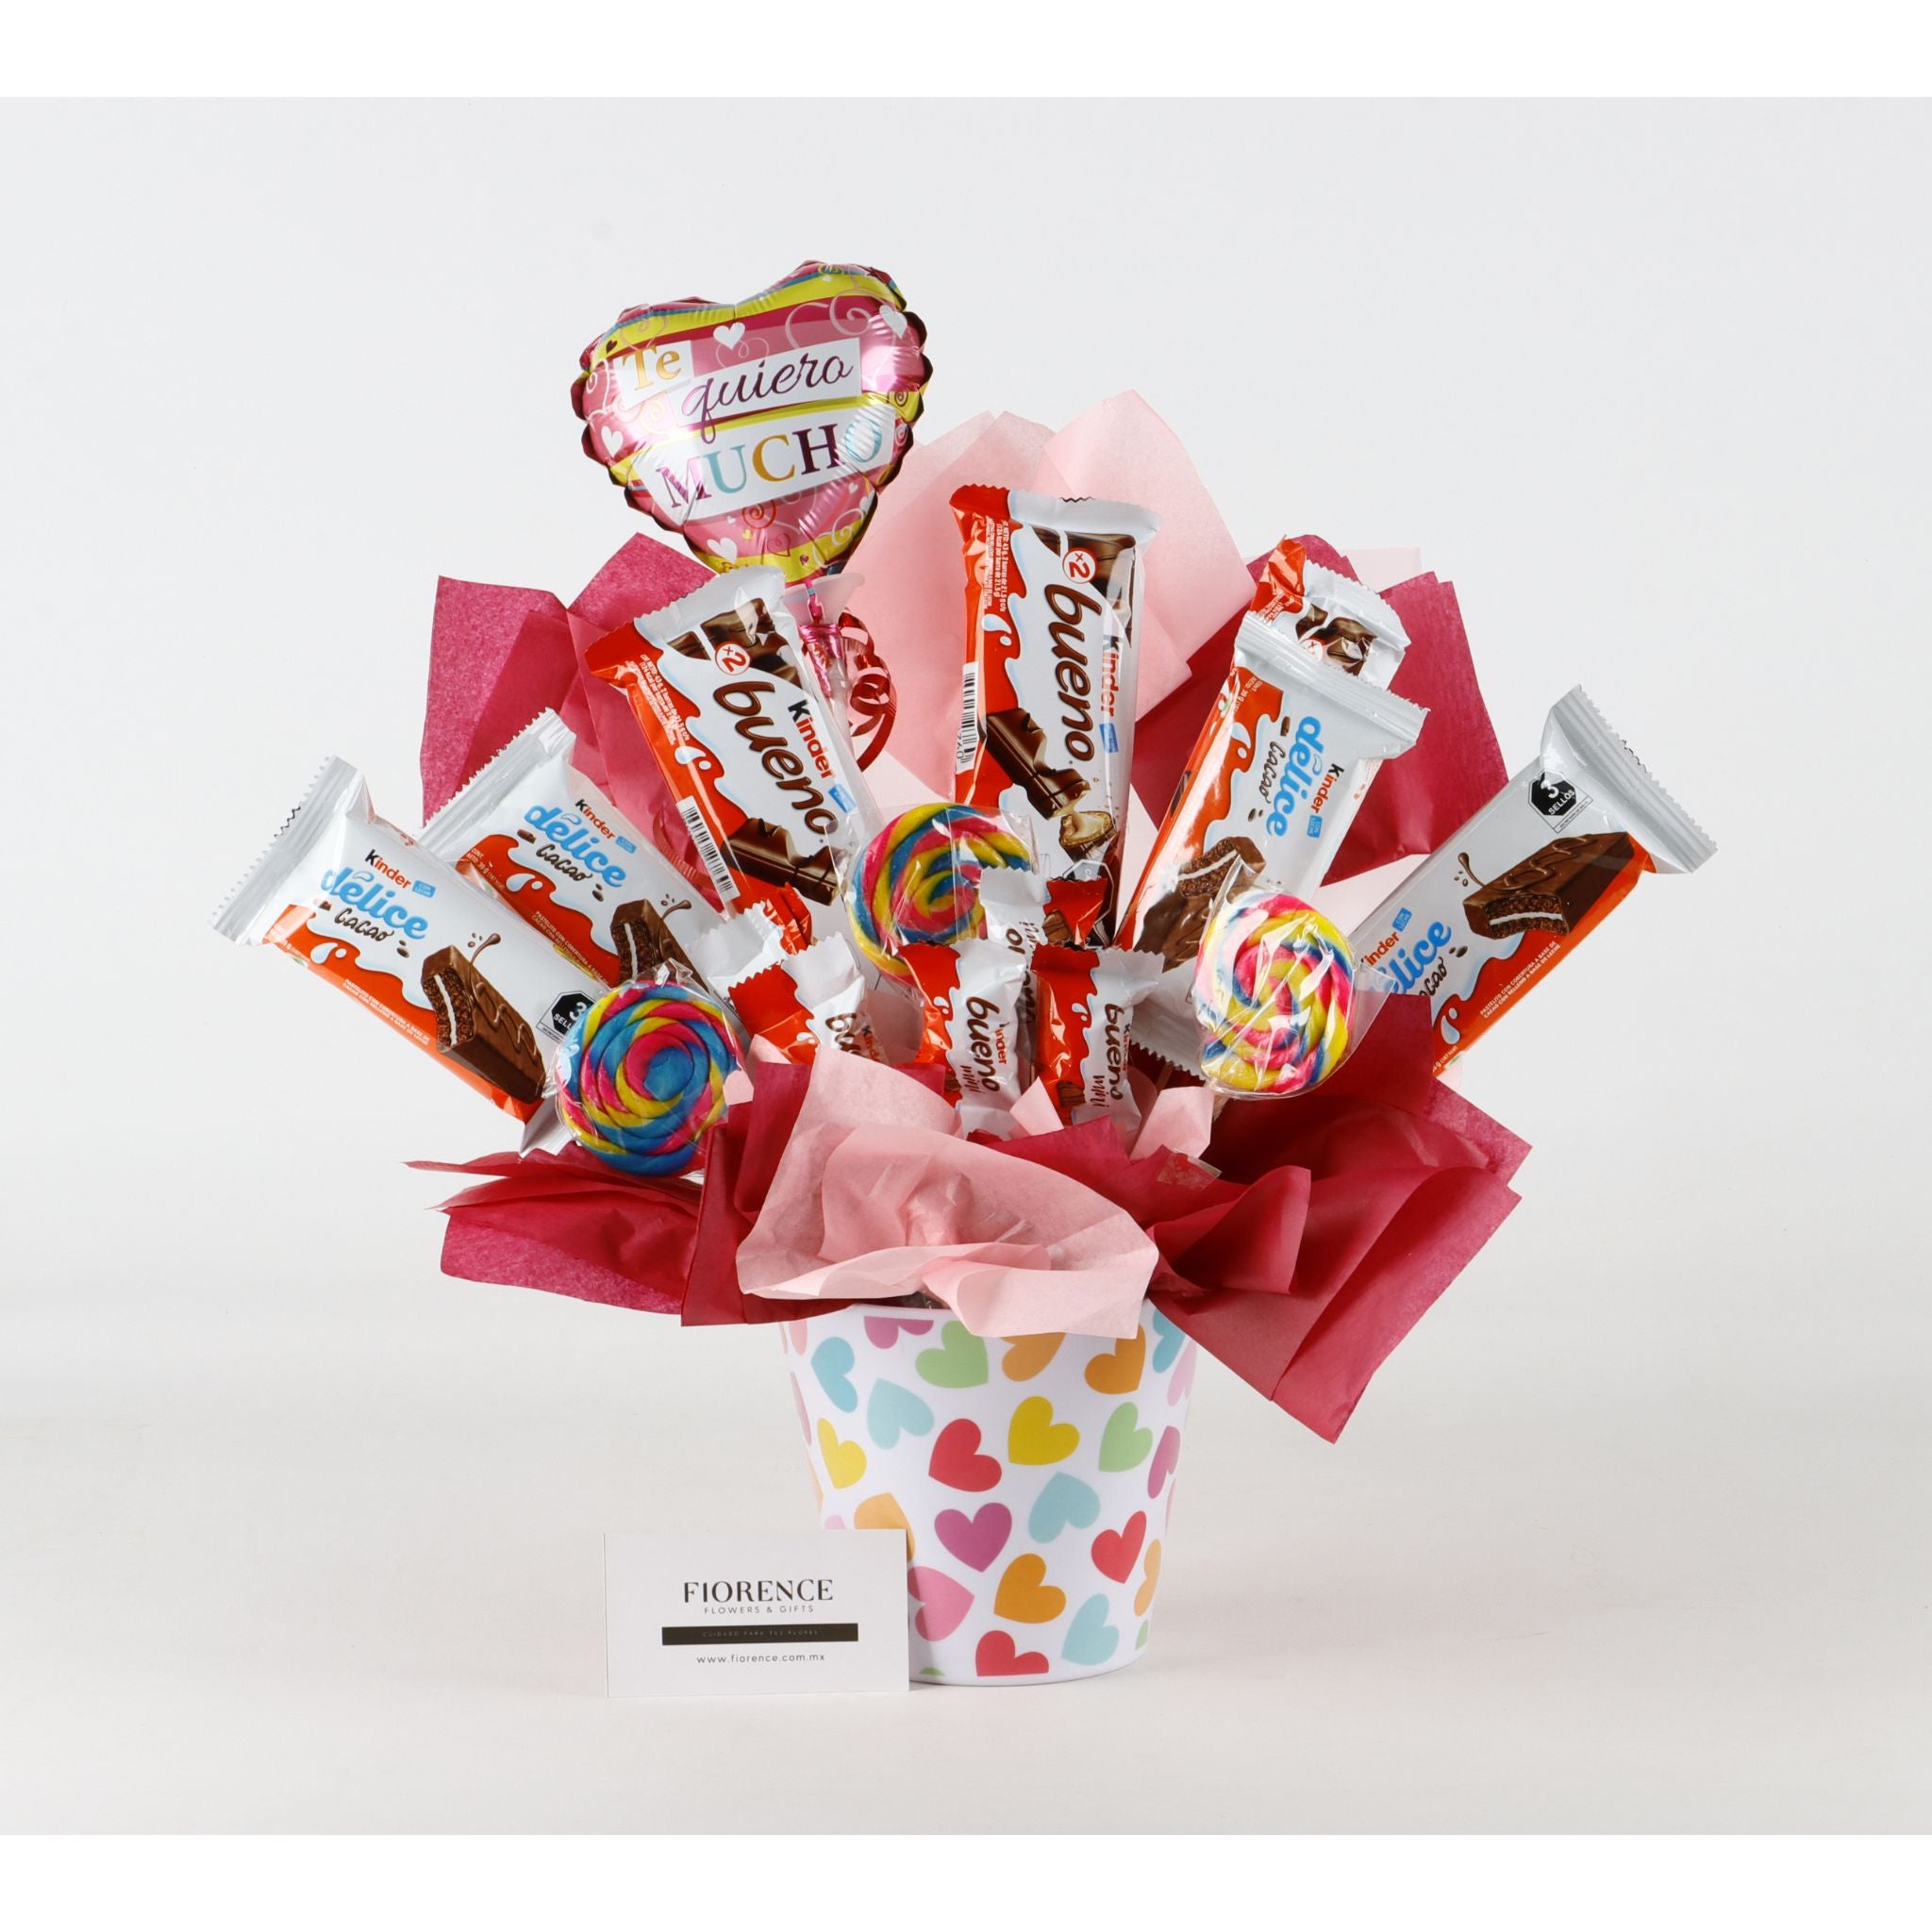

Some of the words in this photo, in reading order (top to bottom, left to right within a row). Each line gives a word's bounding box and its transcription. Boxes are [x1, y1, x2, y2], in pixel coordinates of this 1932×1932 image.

[623, 345, 681, 391] Te
[682, 353, 853, 444] quiero
[657, 419, 883, 508] MUCHO
[1044, 584, 1102, 761] bueno
[713, 681, 839, 835] bueno
[1547, 789, 1575, 817] SELLOS
[555, 931, 565, 941] CON
[563, 940, 588, 965] COBERTURA
[1360, 931, 1400, 966] inder
[1479, 992, 1502, 1015] PASTELITO
[1500, 983, 1511, 995] CON
[1509, 960, 1535, 986] COBERTURA
[1537, 945, 1550, 959] BASE
[1548, 940, 1557, 948] DE
[1482, 1002, 1499, 1019] CACAO
[1497, 993, 1508, 1005] CON
[1507, 975, 1526, 995] RELLENO
[1528, 961, 1541, 974] BASE
[1540, 956, 1548, 964] DE
[368, 995, 379, 1005] CON
[409, 1024, 423, 1036] BASE
[553, 1011, 575, 1030] SELL
[568, 1001, 588, 1022] 3
[966, 996, 1001, 1092] bueno
[1104, 1003, 1125, 1100] bueno
[1092, 1074, 1110, 1108] mini
[684, 1578, 834, 1604] FIORENCE
[704, 1606, 760, 1615] FLOWERS
[766, 1606, 774, 1614] &
[779, 1605, 814, 1613] GIFTS
[696, 1653, 825, 1664] www.fiorence.com.mx
